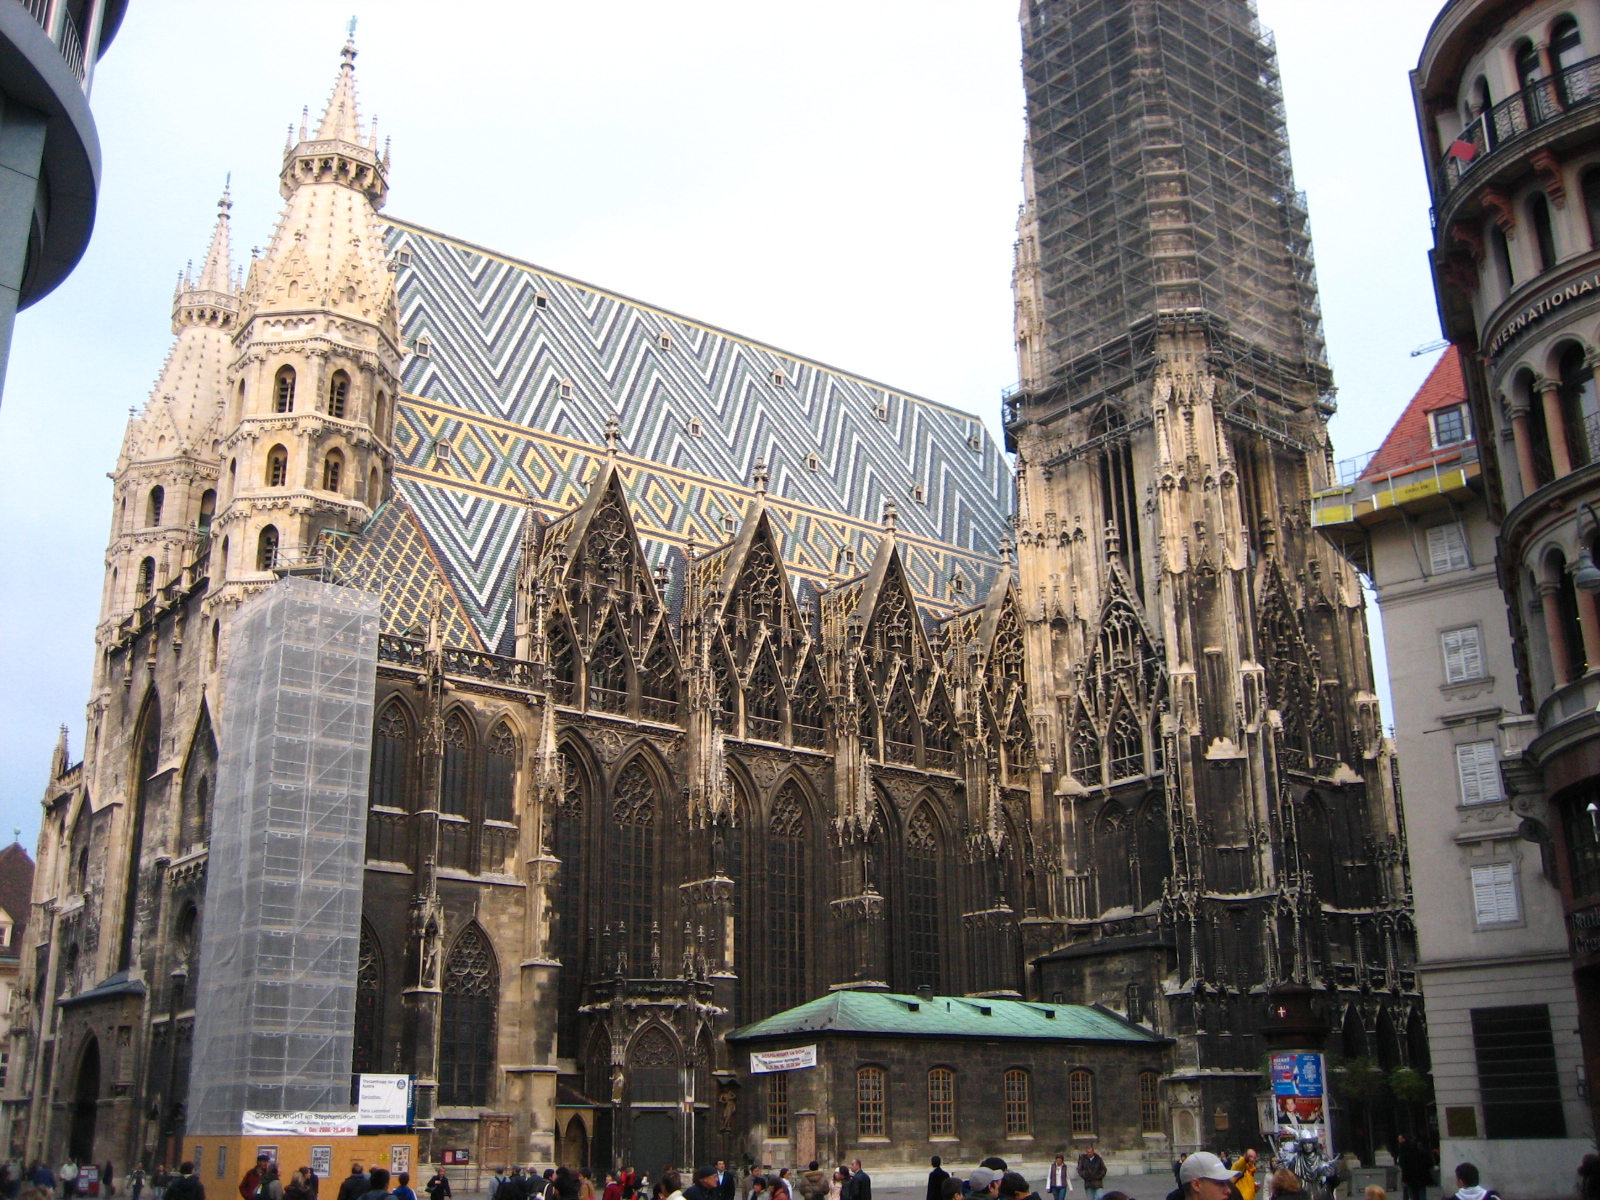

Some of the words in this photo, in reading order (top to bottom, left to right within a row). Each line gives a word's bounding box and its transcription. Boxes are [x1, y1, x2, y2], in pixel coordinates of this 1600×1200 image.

[1489, 274, 1600, 356] INTERNATIONAL
[254, 1112, 303, 1120] GOSPELNIGHT
[314, 1112, 356, 1121] Stephansdom
